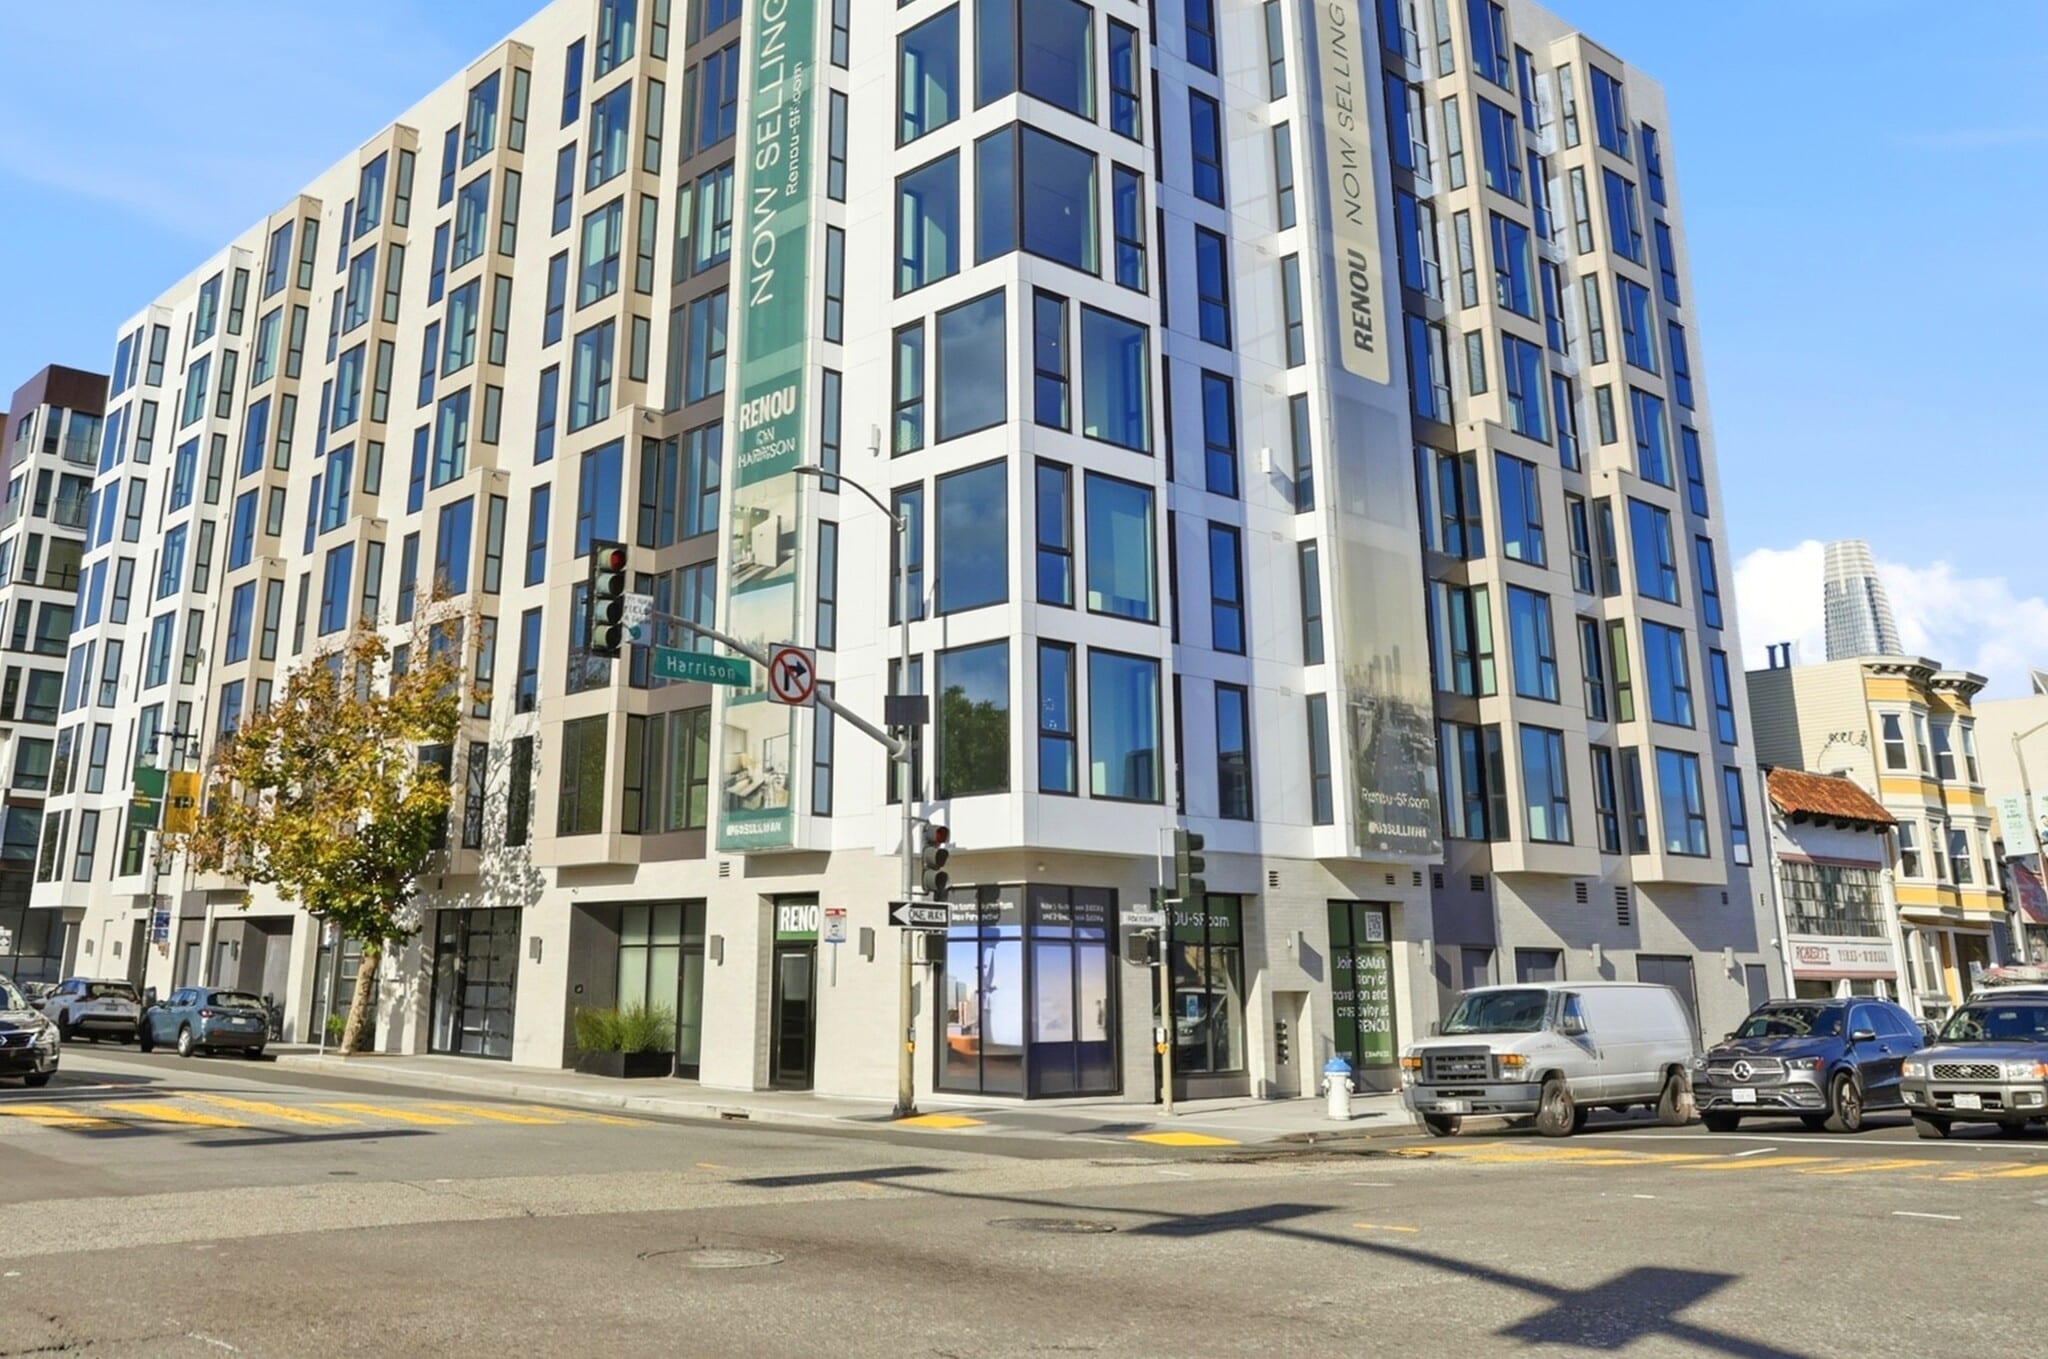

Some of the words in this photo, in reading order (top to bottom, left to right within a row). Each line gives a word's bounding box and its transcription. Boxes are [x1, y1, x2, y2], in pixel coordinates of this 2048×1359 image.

[756, 0, 788, 171] SELLING
[1328, 2, 1354, 131] SELLING
[1341, 138, 1364, 226] NOW
[751, 187, 778, 308] NOW
[1345, 248, 1374, 354] RENOU
[739, 385, 796, 433] RENOU
[756, 426, 775, 445] ON
[738, 437, 796, 469] HARRISON
[667, 656, 736, 681] Harrison
[780, 905, 818, 932] RENO
